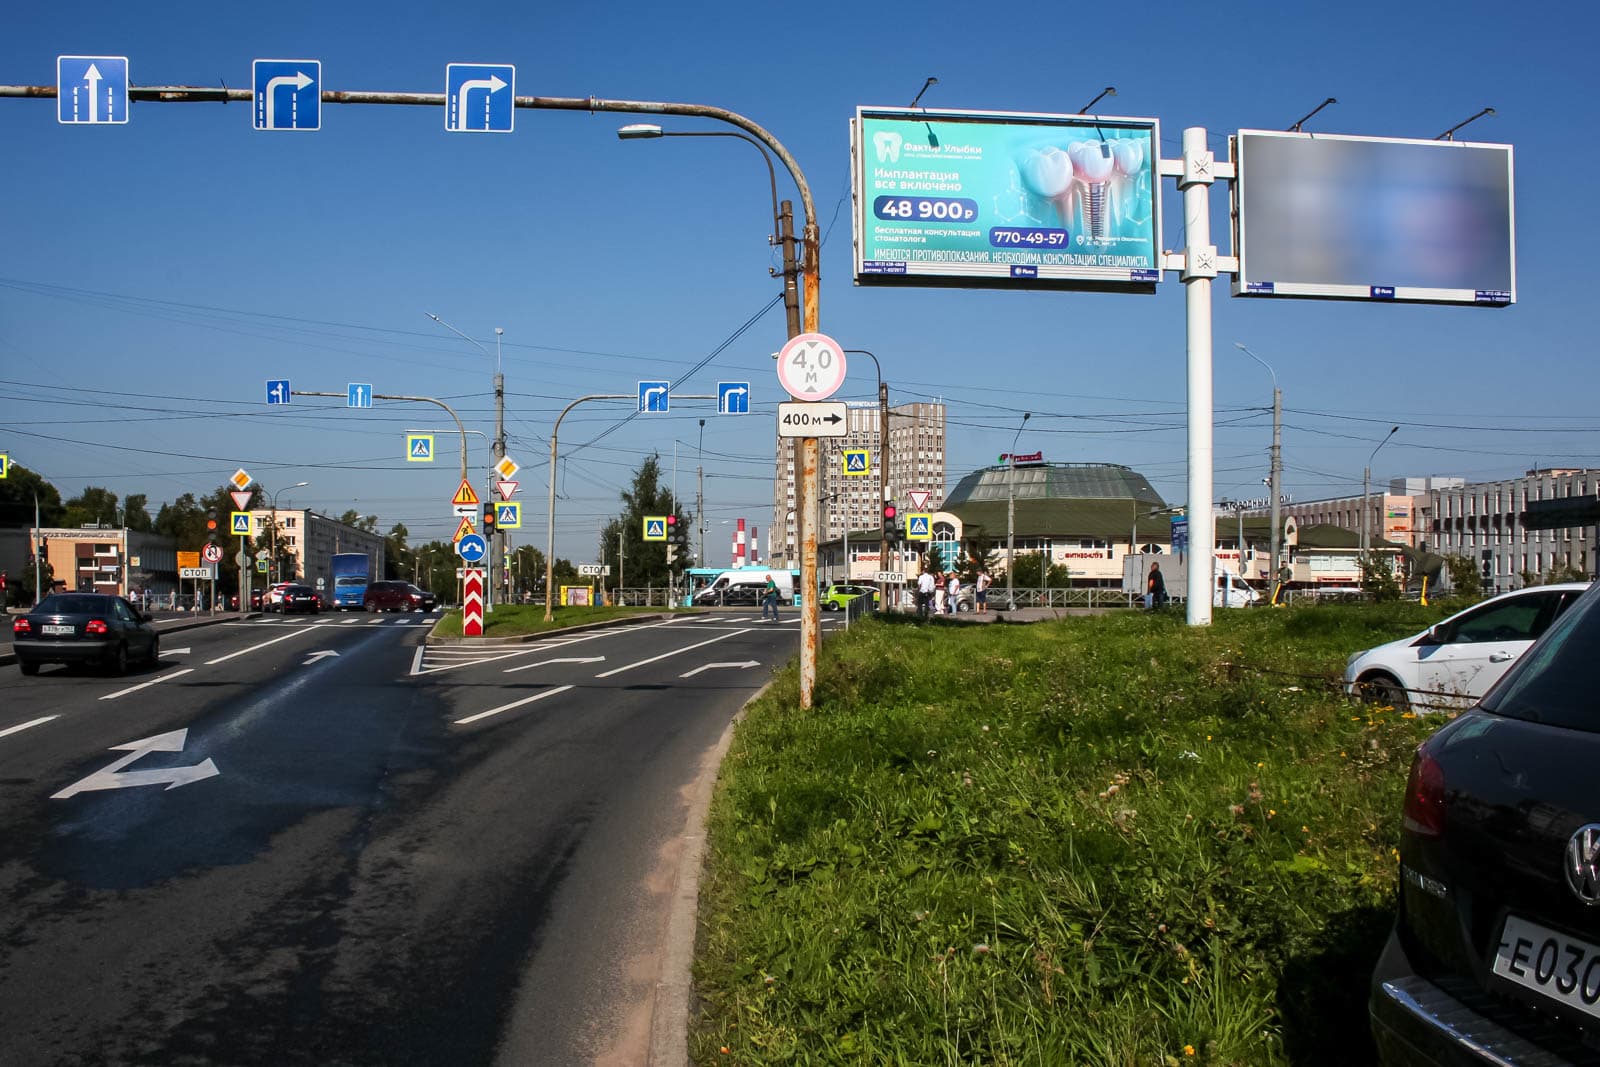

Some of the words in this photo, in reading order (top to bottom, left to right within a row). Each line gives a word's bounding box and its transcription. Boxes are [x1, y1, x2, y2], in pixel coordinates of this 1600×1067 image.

[944, 144, 982, 154] Улыбки
[874, 168, 960, 182] Имплантация
[900, 181, 962, 192] включено
[882, 200, 913, 217] 48
[918, 201, 963, 219] 900
[874, 226, 922, 235] бесплатная
[924, 228, 981, 238] консультация
[994, 231, 1065, 245] 770-49-57
[874, 235, 927, 244] стоматолога
[873, 247, 911, 261] ИМЕЮТСЯ
[992, 251, 1041, 265] НЕОБХОДИМА
[1042, 253, 1097, 267] КОНСУЛЬТАЦИЯ
[1098, 254, 1149, 268] СПЕЦИАЛИСТА
[792, 349, 831, 371] 4,0
[783, 413, 809, 425] 400
[183, 569, 207, 577] СТОП
[878, 573, 903, 581] СТОП
[1508, 937, 1600, 1006] Е030
